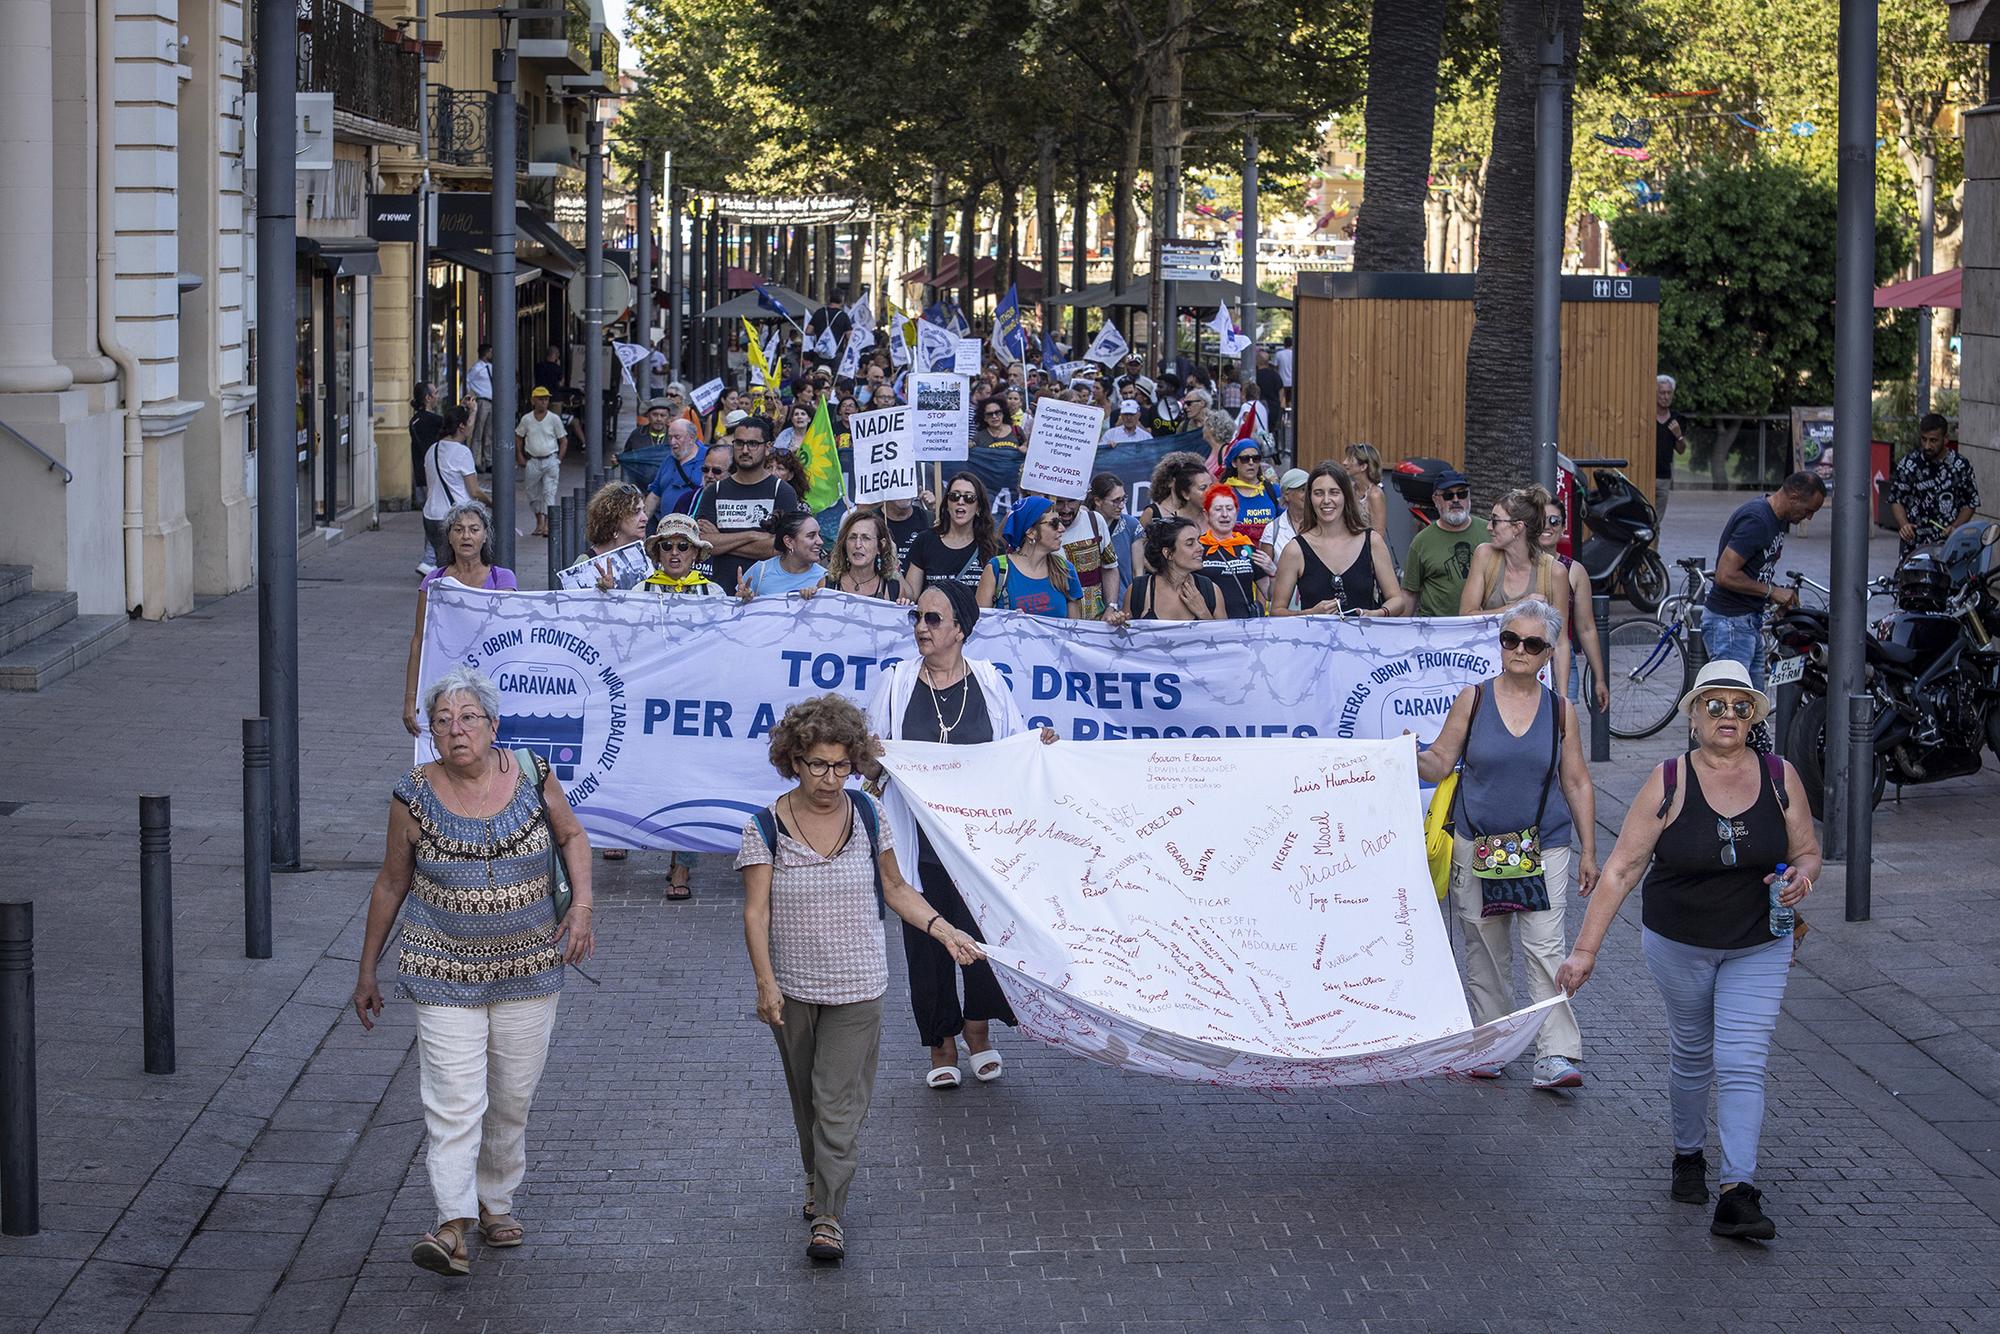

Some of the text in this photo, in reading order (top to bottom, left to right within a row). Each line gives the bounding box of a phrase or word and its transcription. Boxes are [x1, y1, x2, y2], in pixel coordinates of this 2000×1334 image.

[927, 411, 947, 419] STOP
[931, 421, 957, 429] politiques
[1045, 406, 1068, 416] Combien
[1069, 411, 1087, 420] encore
[855, 412, 905, 440] NADIE
[921, 429, 953, 437] migratoires
[1064, 426, 1085, 435] Manche
[870, 441, 898, 464] ES
[1050, 448, 1072, 458] l'Europe
[1055, 441, 1073, 450] portes
[860, 467, 914, 495] ILEGAL!
[1034, 461, 1081, 477] Pour OUVRIR
[1038, 472, 1074, 486] Frontières
[1246, 509, 1272, 517] RIGHTS!
[483, 627, 600, 666] OBRIM FRONTERES
[1371, 658, 1412, 685] OBRIM
[1416, 651, 1491, 676] FRONTERES
[1771, 669, 1801, 684] 251-RM
[500, 673, 577, 695] CARAVANA
[1032, 664, 1183, 711] DRETS
[643, 698, 734, 738] PER
[597, 703, 627, 771] ZABALDUZ
[1293, 770, 1377, 795] Luis Humberto
[1053, 793, 1126, 845] SILVERIO
[1135, 815, 1171, 840] PEREZ
[984, 818, 1038, 846] Adolfo
[1309, 810, 1334, 858] Misael
[1165, 841, 1194, 878] GERARDO
[1271, 830, 1299, 872] VICENTE
[1192, 847, 1217, 884] WILMER
[1082, 886, 1109, 899] Pedro
[1309, 892, 1369, 913] Jorge Francisco
[1397, 927, 1415, 968] Carlos
[1338, 993, 1417, 1021] FRANCISCO ANTONIO
